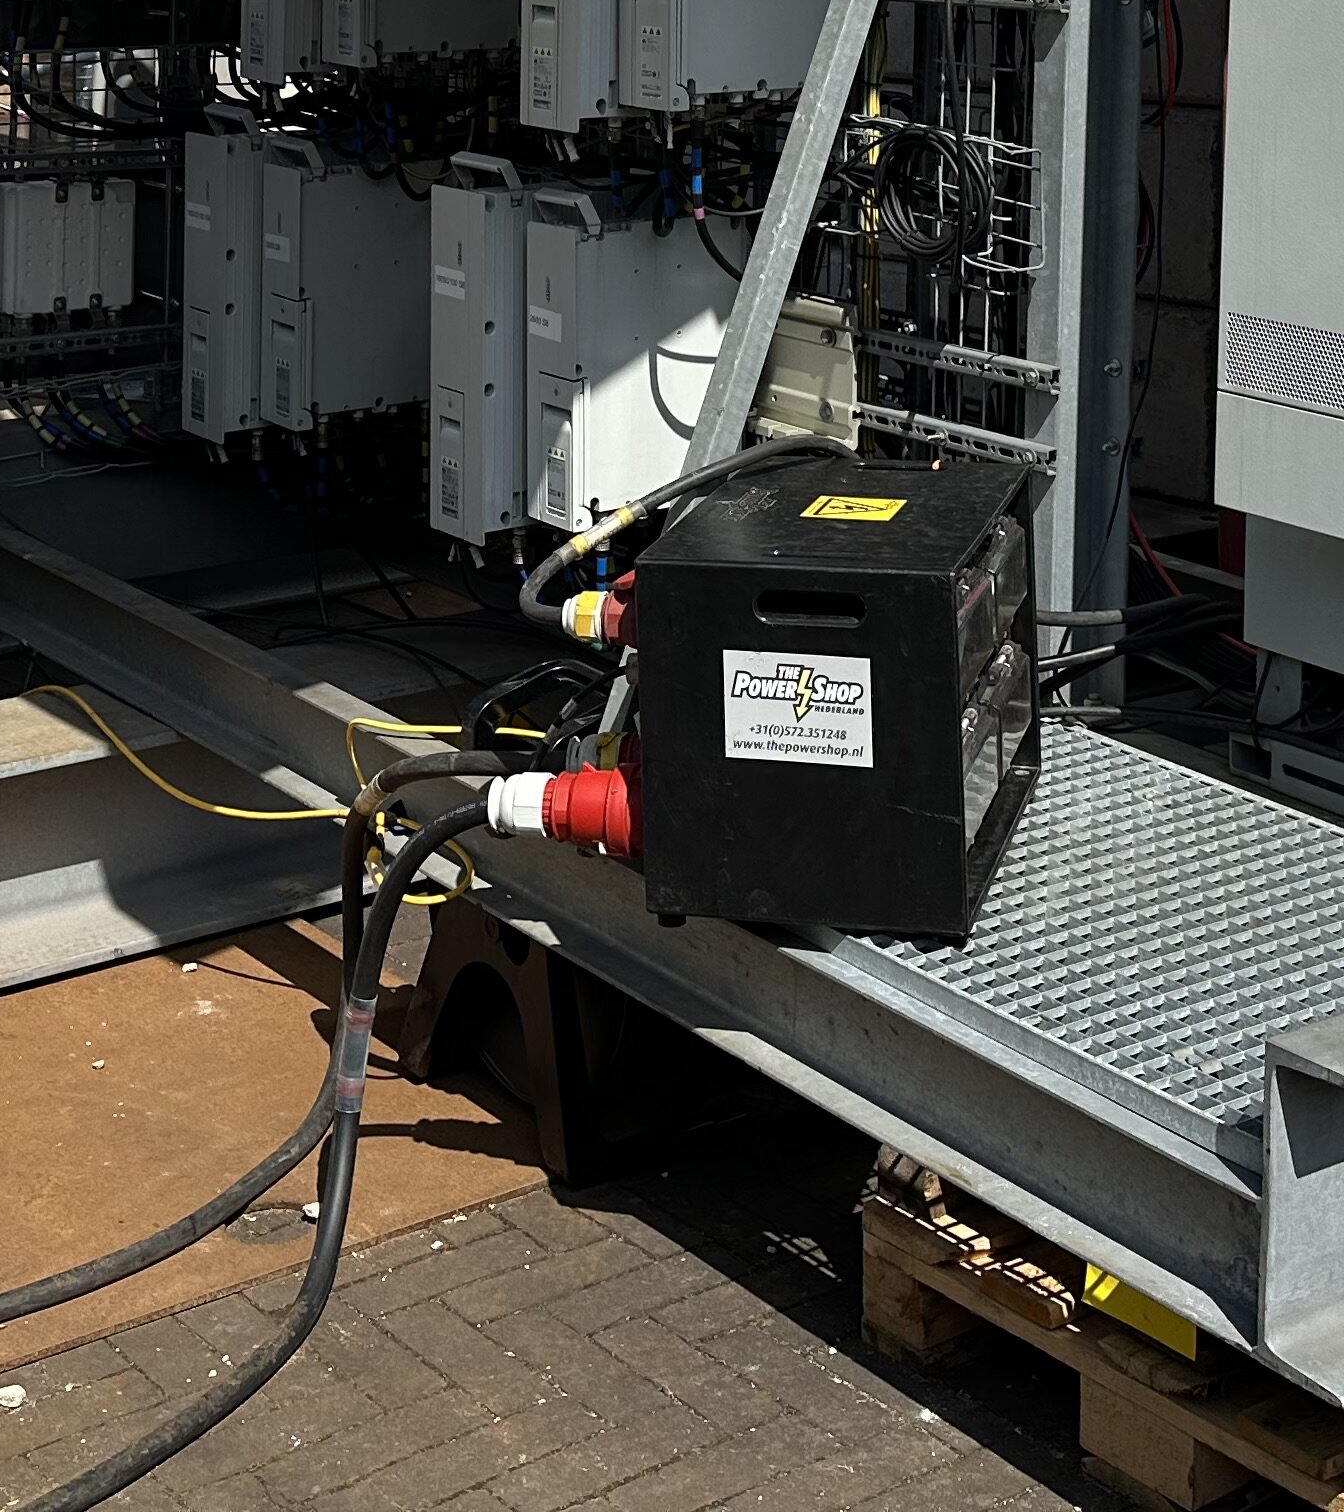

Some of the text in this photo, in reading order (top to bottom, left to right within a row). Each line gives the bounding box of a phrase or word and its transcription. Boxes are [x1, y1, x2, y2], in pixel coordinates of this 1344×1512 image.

[777, 664, 801, 680] THE
[731, 670, 864, 705] POWER SHOP
[813, 704, 865, 716] NEDERLAND
[749, 723, 848, 741] +31(0)572.351248
[732, 739, 865, 759] www.thepowershop.nl
